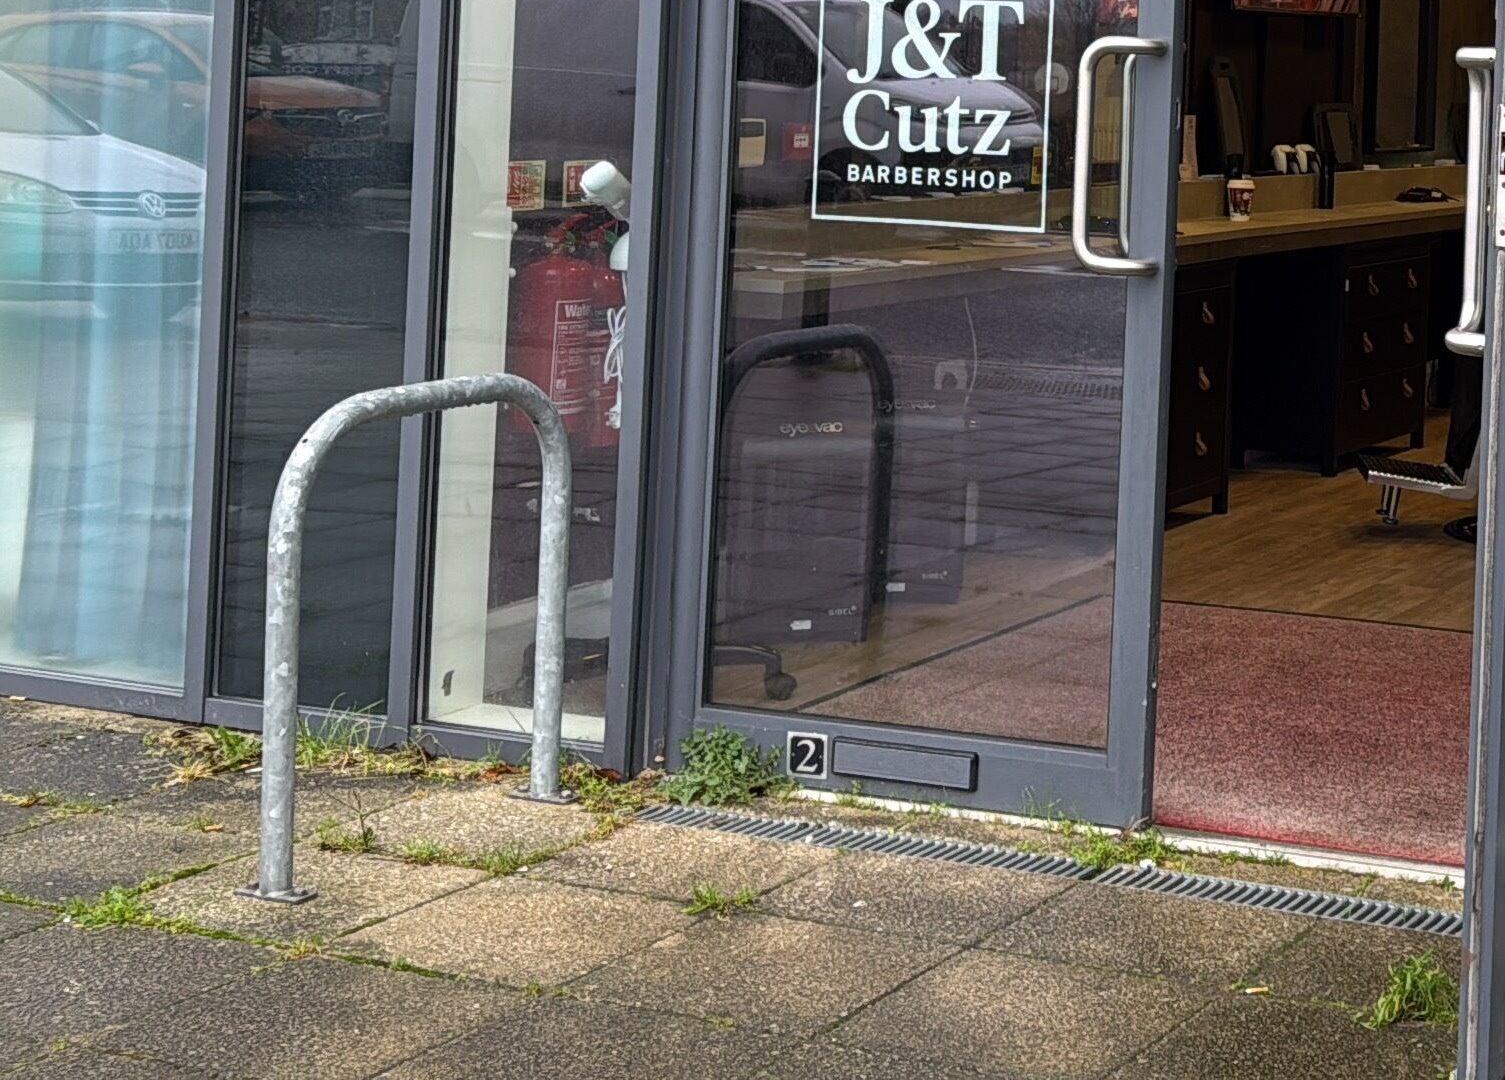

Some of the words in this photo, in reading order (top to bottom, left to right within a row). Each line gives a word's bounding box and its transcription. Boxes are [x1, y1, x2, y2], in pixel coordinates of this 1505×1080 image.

[843, 89, 1011, 155] Cutz
[848, 164, 1012, 189] BARBERSHOP
[795, 739, 818, 773] 2
